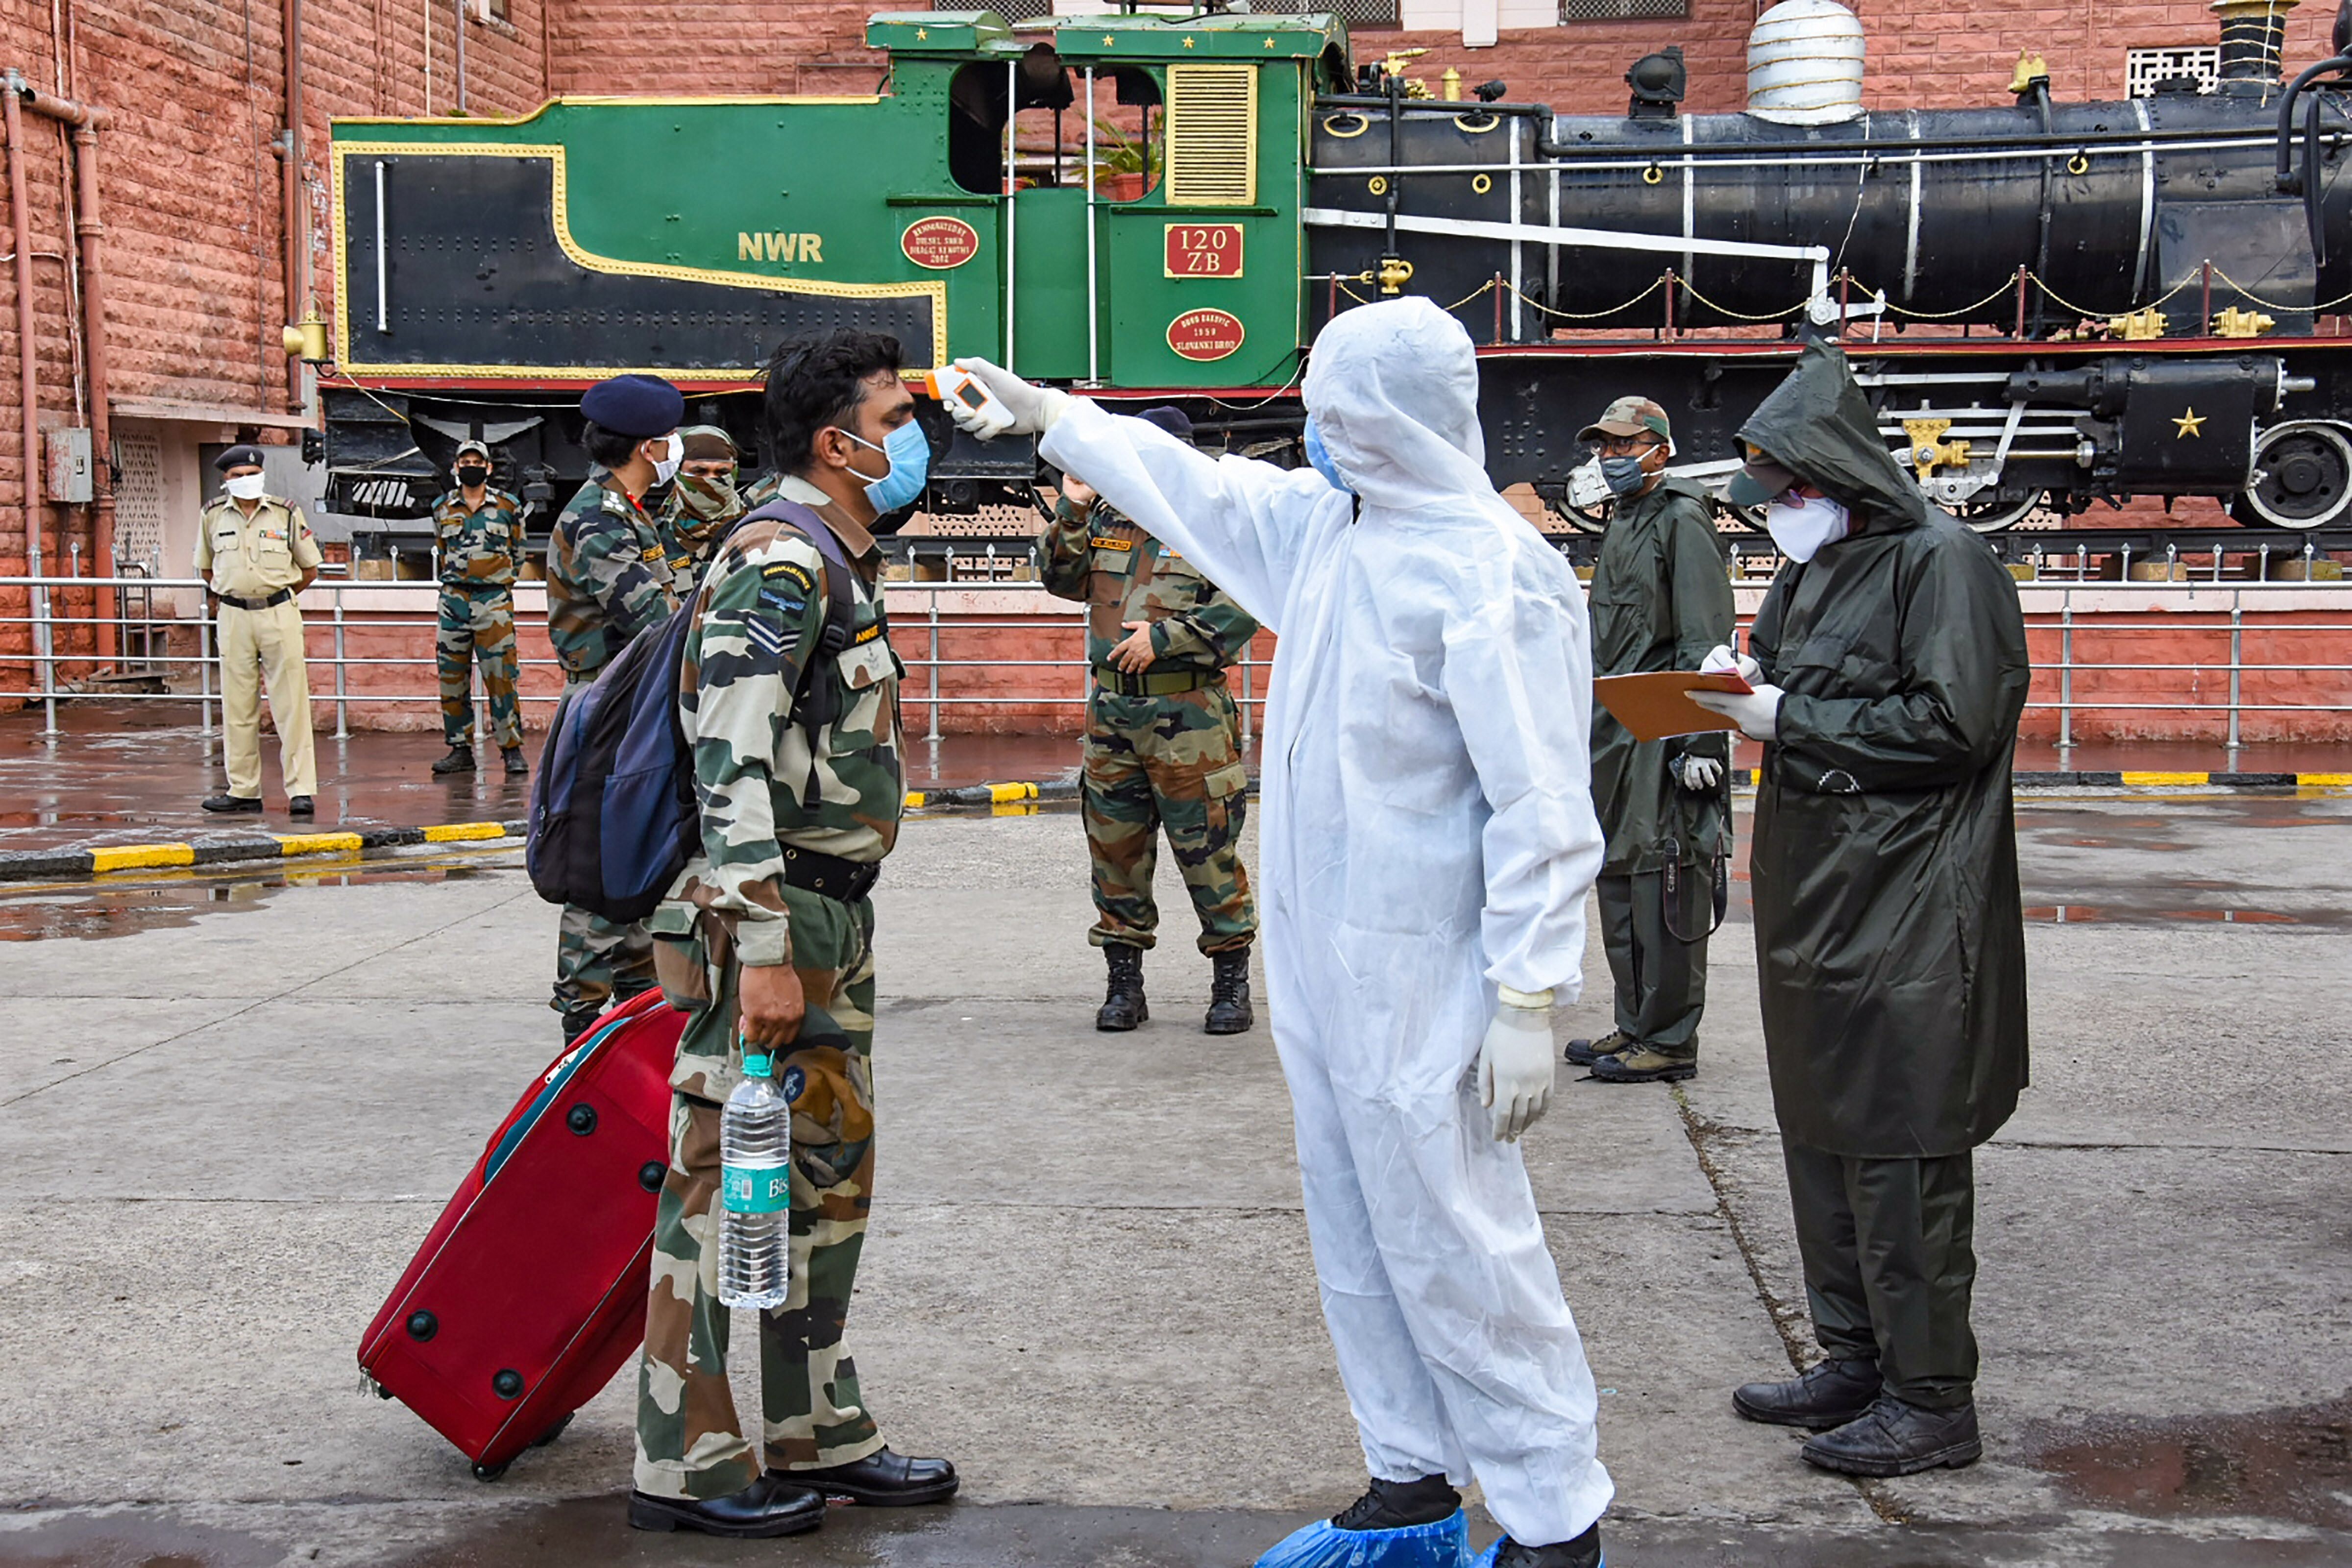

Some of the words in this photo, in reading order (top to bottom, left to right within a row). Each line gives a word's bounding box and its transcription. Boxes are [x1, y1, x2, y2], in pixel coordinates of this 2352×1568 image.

[738, 232, 823, 262] NWR
[1181, 230, 1226, 249] 120
[1187, 252, 1220, 271] ZB
